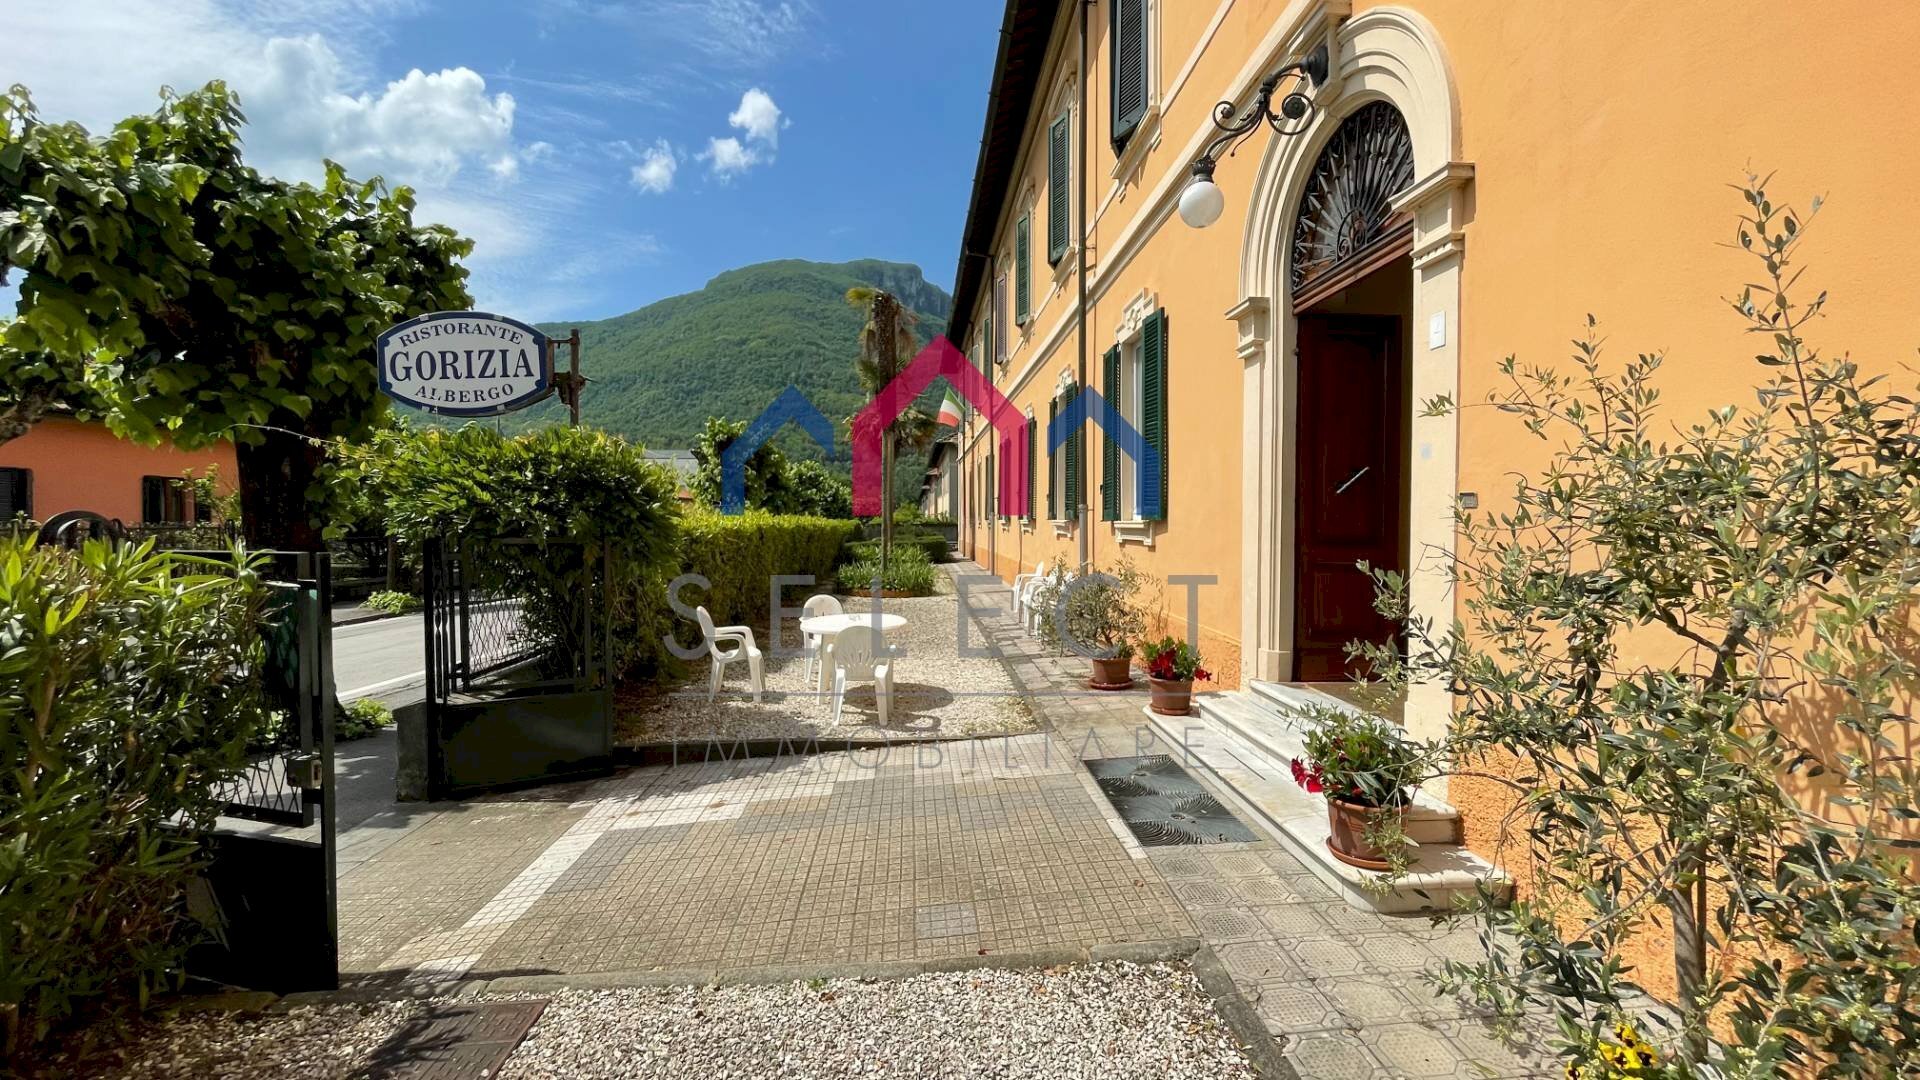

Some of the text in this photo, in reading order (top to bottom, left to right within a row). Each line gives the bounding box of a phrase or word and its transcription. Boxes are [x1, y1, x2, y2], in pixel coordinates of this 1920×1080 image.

[399, 322, 524, 348] RISTORANTE
[389, 348, 535, 382] GORIZIA
[415, 383, 514, 403] ALBERGO
